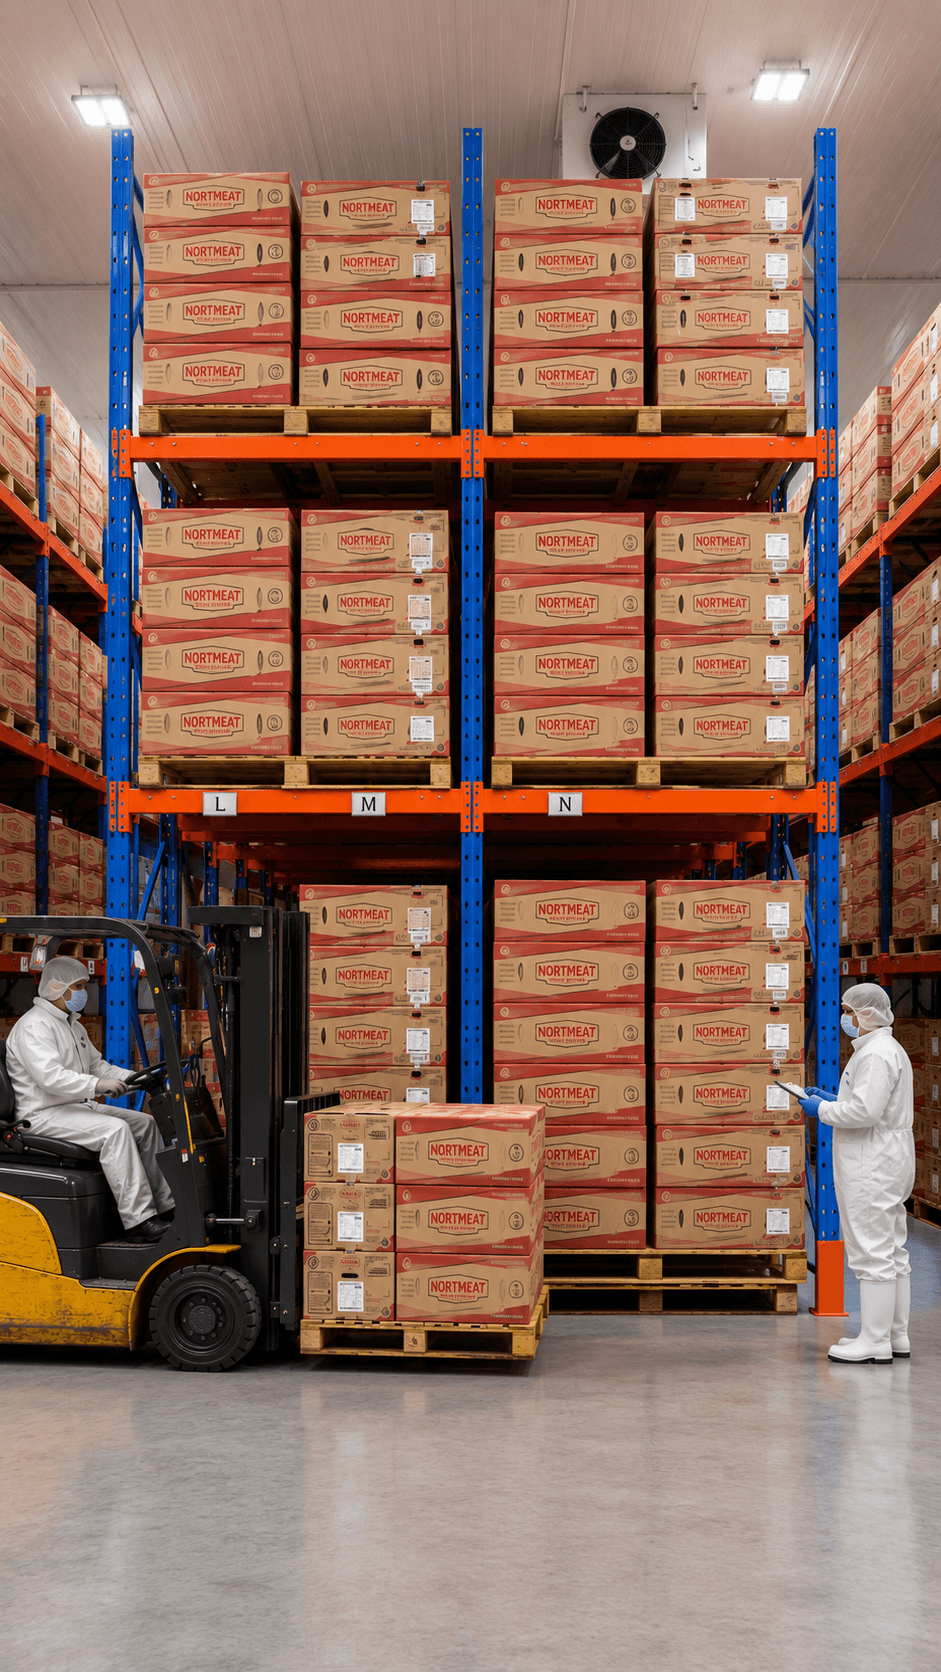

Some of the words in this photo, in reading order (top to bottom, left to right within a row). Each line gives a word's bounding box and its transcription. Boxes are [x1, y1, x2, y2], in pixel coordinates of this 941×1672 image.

[185, 191, 242, 202] NORTMEAT
[341, 202, 394, 213] NORTMEAT
[538, 199, 595, 210] NORTMEAT
[698, 198, 747, 210] NORTMEAT
[185, 245, 242, 257] NORTMEAT
[343, 257, 397, 268] NORTMEAT
[538, 255, 595, 267] NORTMEAT
[698, 255, 747, 266] NORTMEAT
[185, 305, 242, 316] NORTMEAT
[343, 312, 400, 324] NORTMEAT
[538, 312, 595, 323] NORTMEAT
[698, 312, 748, 323] NORTMEAT
[185, 366, 242, 377] NORTMEAT
[343, 372, 400, 383] NORTMEAT
[538, 370, 595, 381] NORTMEAT
[698, 371, 748, 382] NORTMEAT
[184, 528, 241, 540] NORTMEAT
[340, 535, 391, 547] NORTMEAT
[538, 536, 596, 548] NORTMEAT
[695, 536, 747, 548] NORTMEAT
[184, 589, 241, 601] NORTMEAT
[340, 597, 391, 608] NORTMEAT
[538, 597, 596, 609] NORTMEAT
[695, 598, 747, 609] NORTMEAT
[184, 652, 241, 664] NORTMEAT
[538, 658, 596, 669] NORTMEAT
[340, 659, 391, 670] NORTMEAT
[695, 659, 747, 670] NORTMEAT
[183, 716, 241, 728] NORTMEAT
[340, 720, 391, 731] NORTMEAT
[538, 719, 597, 731] NORTMEAT
[696, 720, 748, 731] NORTMEAT
[216, 797, 225, 811] L
[361, 797, 376, 811] M
[559, 797, 572, 811] N
[339, 908, 390, 920] NORTMEAT
[538, 903, 596, 915] NORTMEAT
[696, 904, 747, 914] NORTMEAT
[338, 970, 389, 981] NORTMEAT
[538, 965, 596, 977] NORTMEAT
[695, 965, 747, 977] NORTMEAT
[338, 1030, 388, 1041] NORTMEAT
[538, 1026, 596, 1038] NORTMEAT
[695, 1026, 747, 1038] NORTMEAT
[538, 1087, 596, 1099] NORTMEAT
[696, 1088, 748, 1099] NORTMEAT
[430, 1144, 486, 1157] NORTMEAT
[696, 1150, 748, 1161] NORTMEAT
[430, 1212, 486, 1225] NORTMEAT
[696, 1212, 748, 1223] NORTMEAT
[430, 1280, 486, 1293] NORTMEAT
